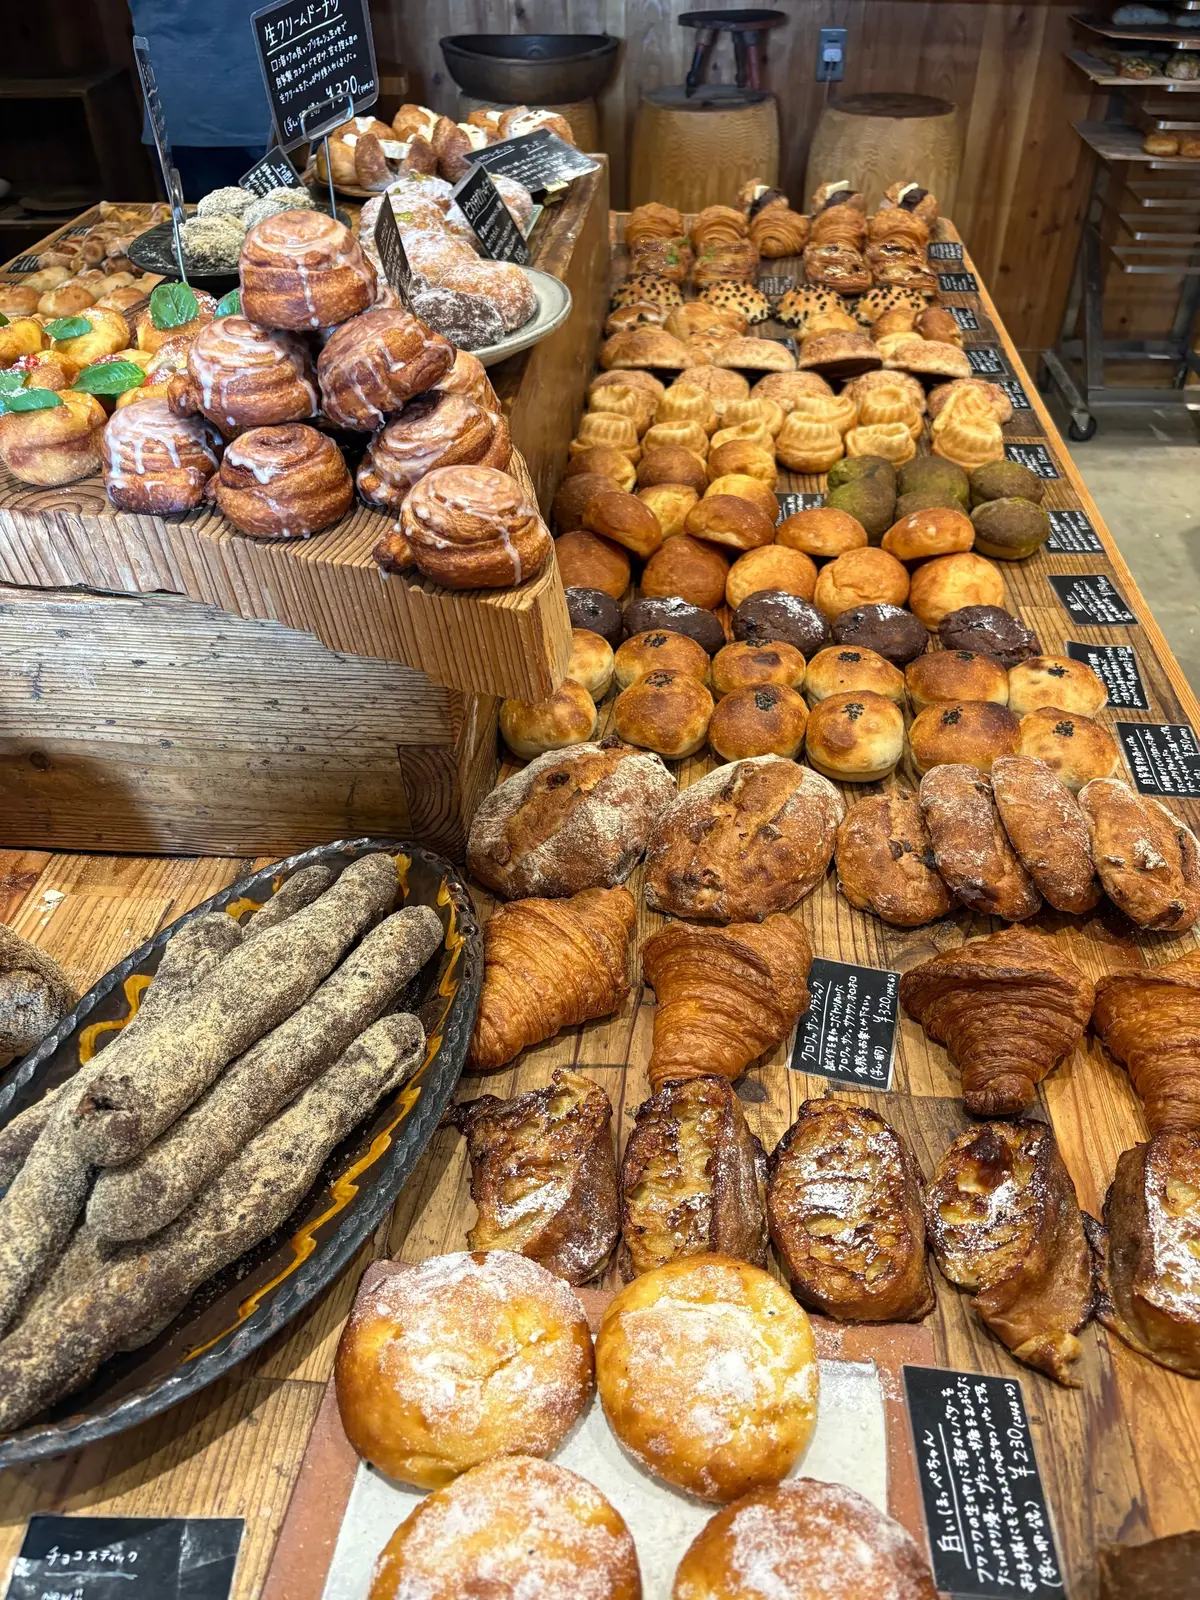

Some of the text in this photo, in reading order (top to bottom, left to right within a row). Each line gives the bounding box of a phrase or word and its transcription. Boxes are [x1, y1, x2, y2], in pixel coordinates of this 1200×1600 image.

[923, 1430, 963, 1552] 白いほっぺちゃん
[44, 1545, 138, 1567] チョコスティック
